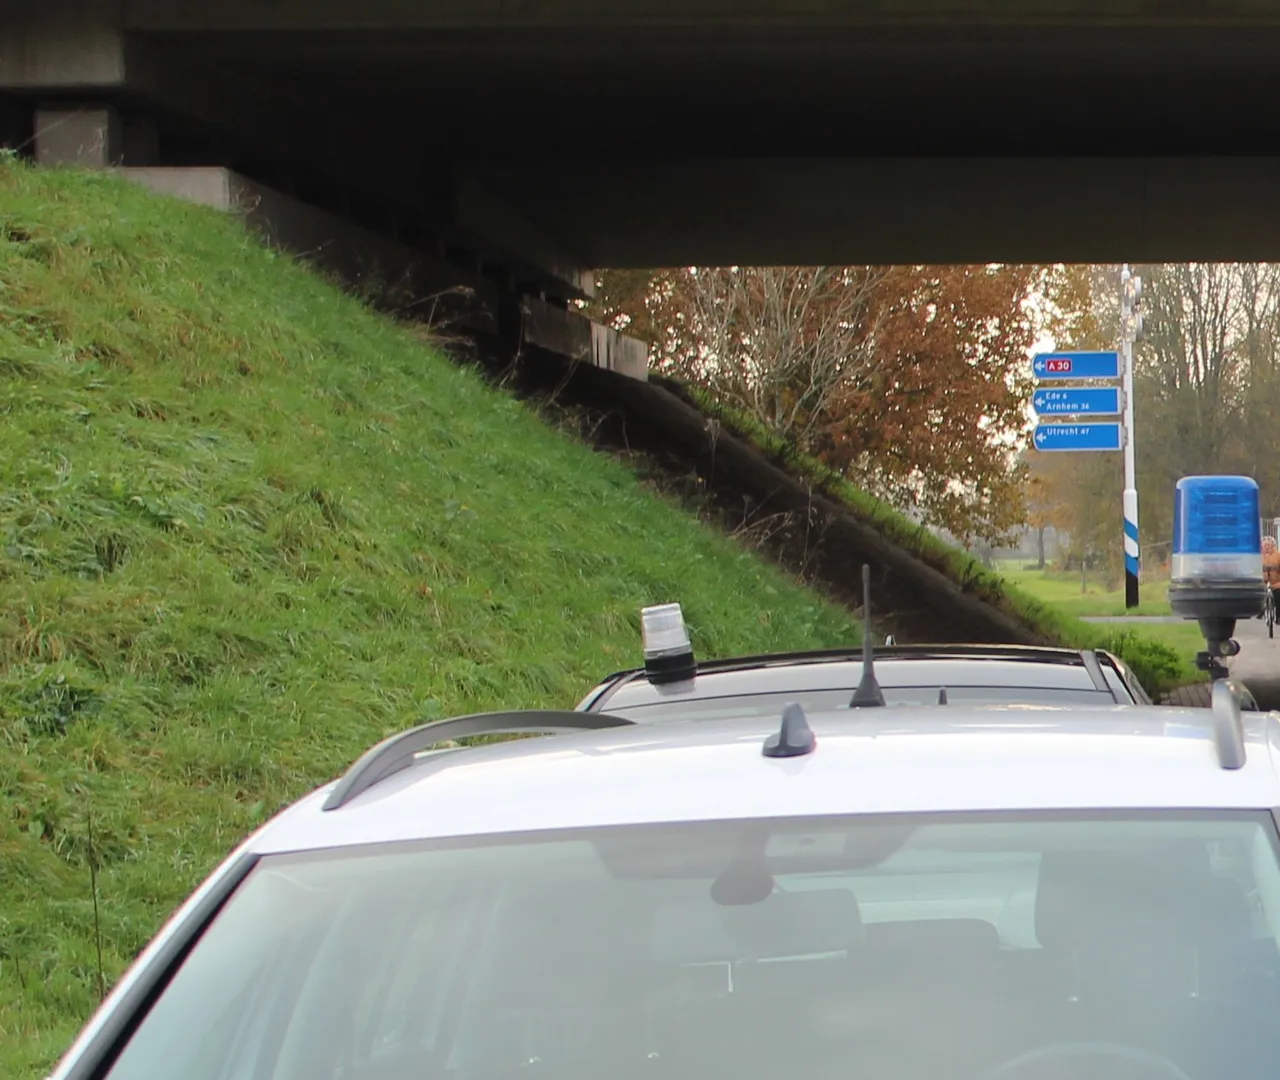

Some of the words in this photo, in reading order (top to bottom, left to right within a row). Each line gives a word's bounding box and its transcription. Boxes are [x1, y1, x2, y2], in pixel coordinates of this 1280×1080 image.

[1048, 361, 1056, 371] A
[1057, 361, 1070, 370] 30
[1045, 392, 1061, 400] Ede
[1046, 402, 1079, 411] Arnhem
[1046, 427, 1079, 436] Utrecht
